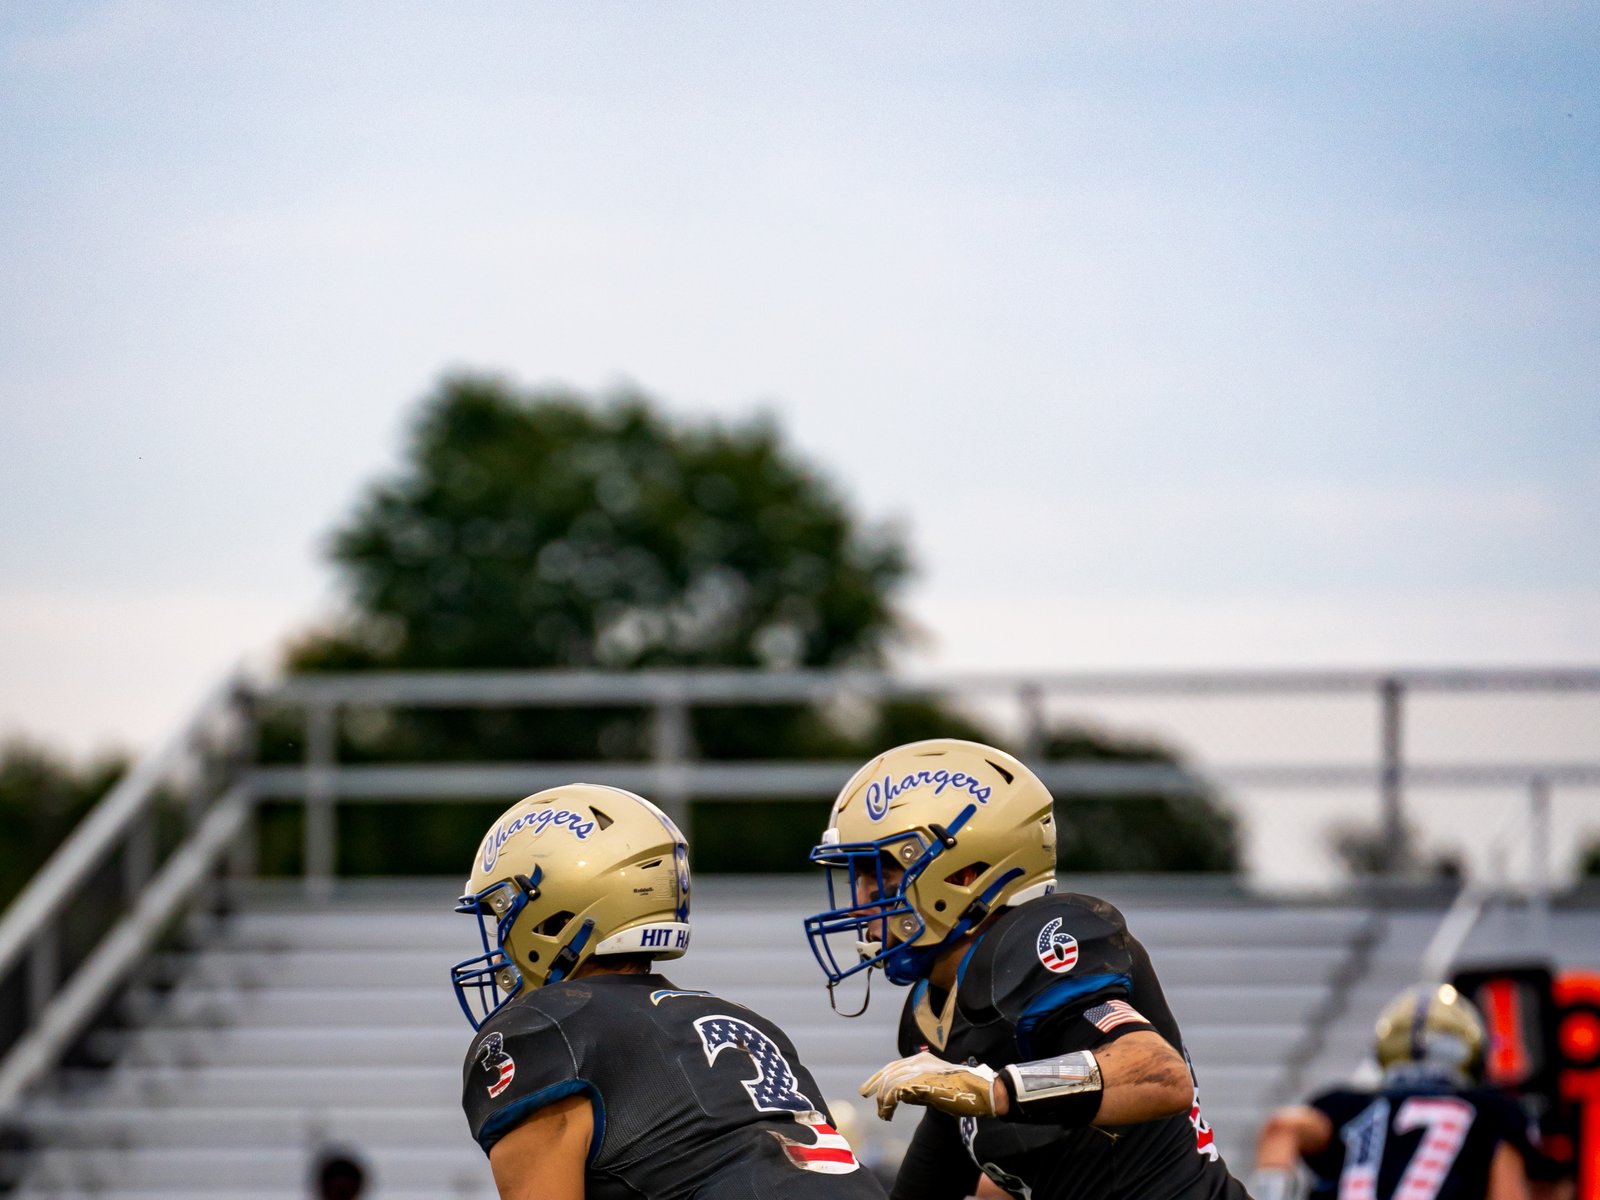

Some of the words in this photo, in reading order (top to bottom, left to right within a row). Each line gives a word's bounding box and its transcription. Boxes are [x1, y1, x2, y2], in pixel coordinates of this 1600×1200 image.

[866, 769, 992, 821] Chargers
[482, 807, 595, 873] Chargers
[640, 928, 673, 947] HIT
[1037, 916, 1079, 974] 6
[475, 1031, 516, 1099] 3
[692, 1014, 860, 1175] 3
